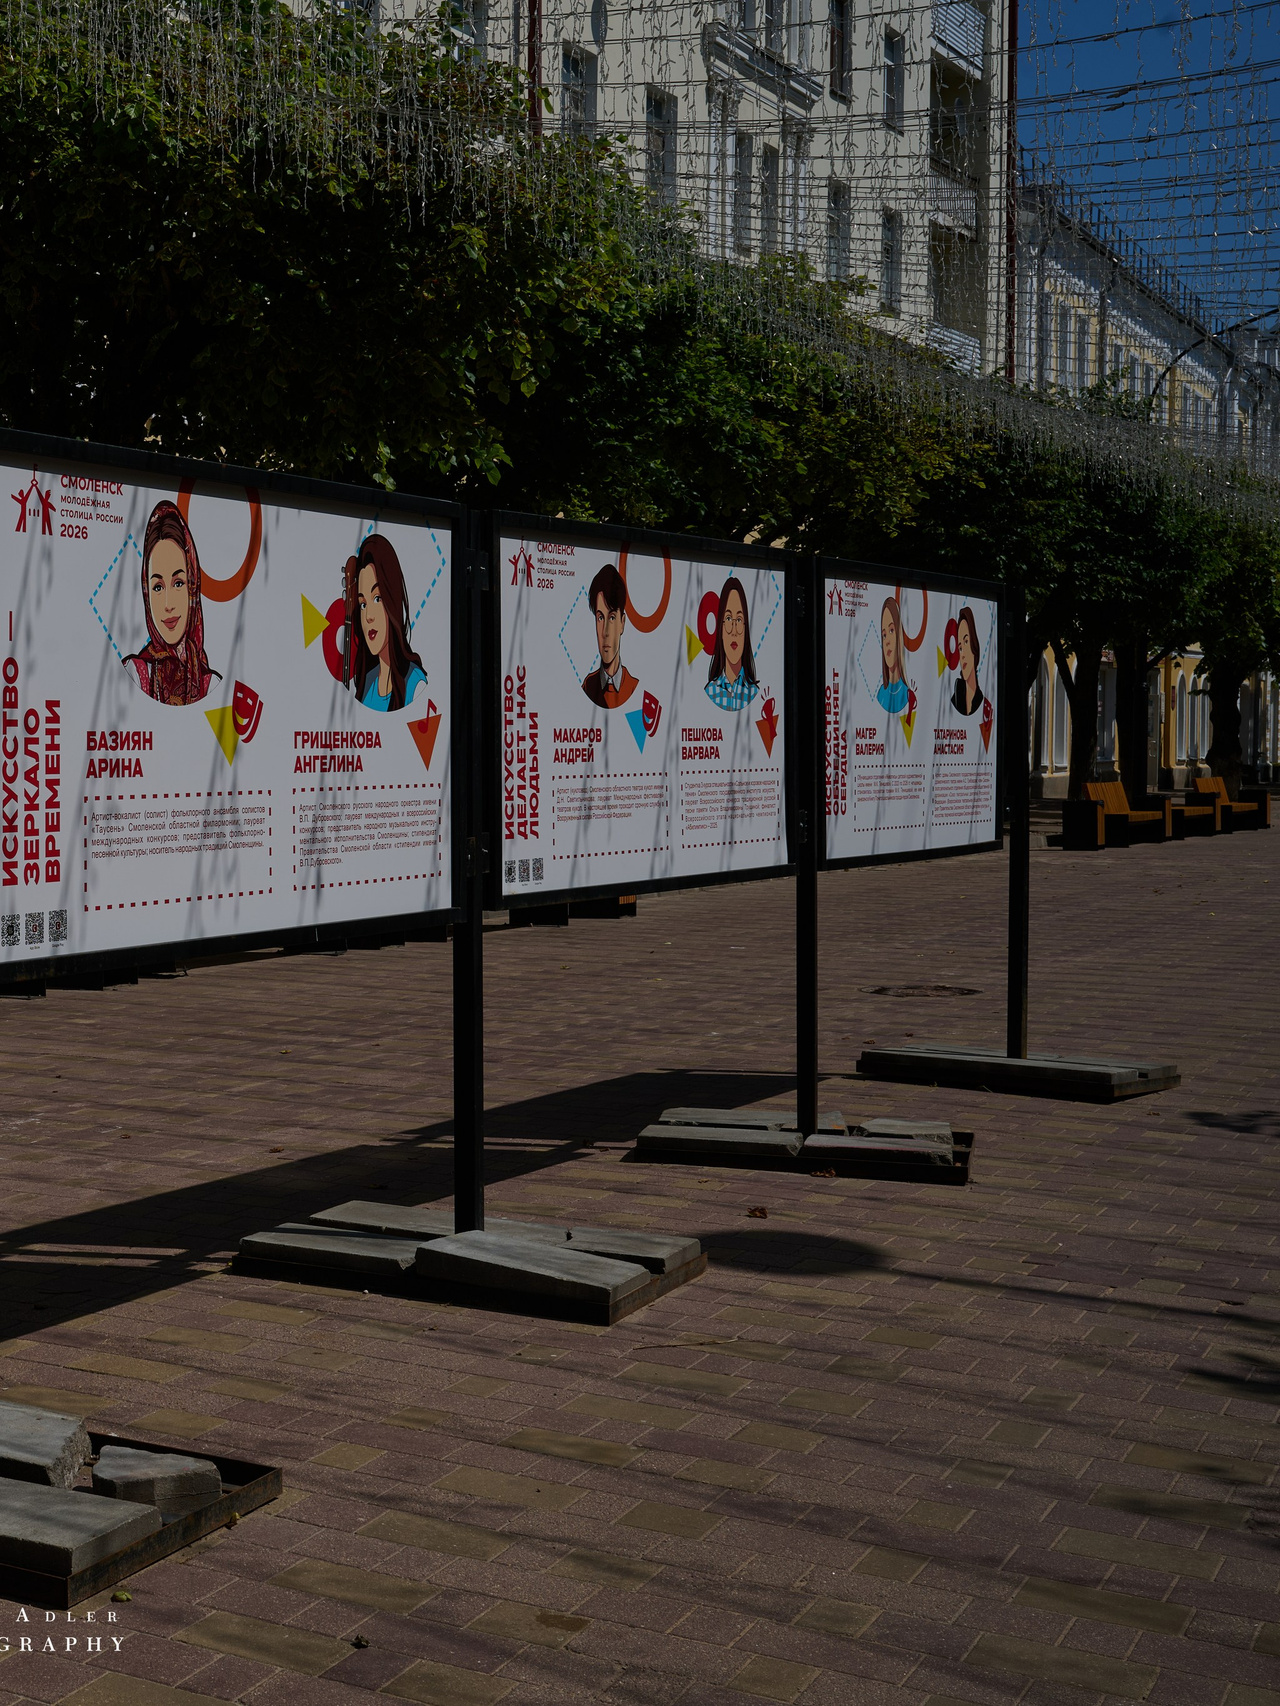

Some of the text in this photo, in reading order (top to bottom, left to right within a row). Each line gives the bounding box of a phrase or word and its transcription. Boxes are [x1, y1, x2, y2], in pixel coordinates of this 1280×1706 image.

[61, 474, 123, 496] СМОЛЕНСК
[61, 495, 111, 509] МОЛОДЁЖНАЯ
[60, 508, 124, 524] СТОЛИЦА РОССИИ
[60, 523, 88, 540] 2026
[537, 542, 575, 556] СМОЛЕНСК
[537, 578, 554, 590] 2026
[86, 731, 153, 751] БАЗИЯН
[294, 731, 382, 751] ГРИЩЕНКОВА
[553, 728, 602, 743] МАКАРОВ
[681, 728, 723, 742] ПЕШКОВА
[855, 728, 877, 740] МАГЕР
[933, 729, 967, 740] ТАТАРИНОВА
[504, 675, 515, 840] ИСКУССТВО
[517, 665, 528, 840] ДЕЛАЕТ НАС
[553, 744, 594, 764] АНДРЕЙ
[681, 746, 720, 760] ВАРВАРА
[855, 743, 884, 755] ВАЛЕРИЯ
[933, 744, 964, 755] АНАСТАСИЯ
[2, 657, 19, 886] ИСКУССТВО
[86, 758, 144, 778] АРИНА
[293, 755, 363, 773] АНГЕЛИНА
[840, 729, 848, 815] СЕРДЦА
[529, 712, 540, 839] ЛЮДЬМИ
[23, 707, 40, 886] ЗЕРКАЛО
[45, 700, 60, 883] ВРЕМЕНИ
